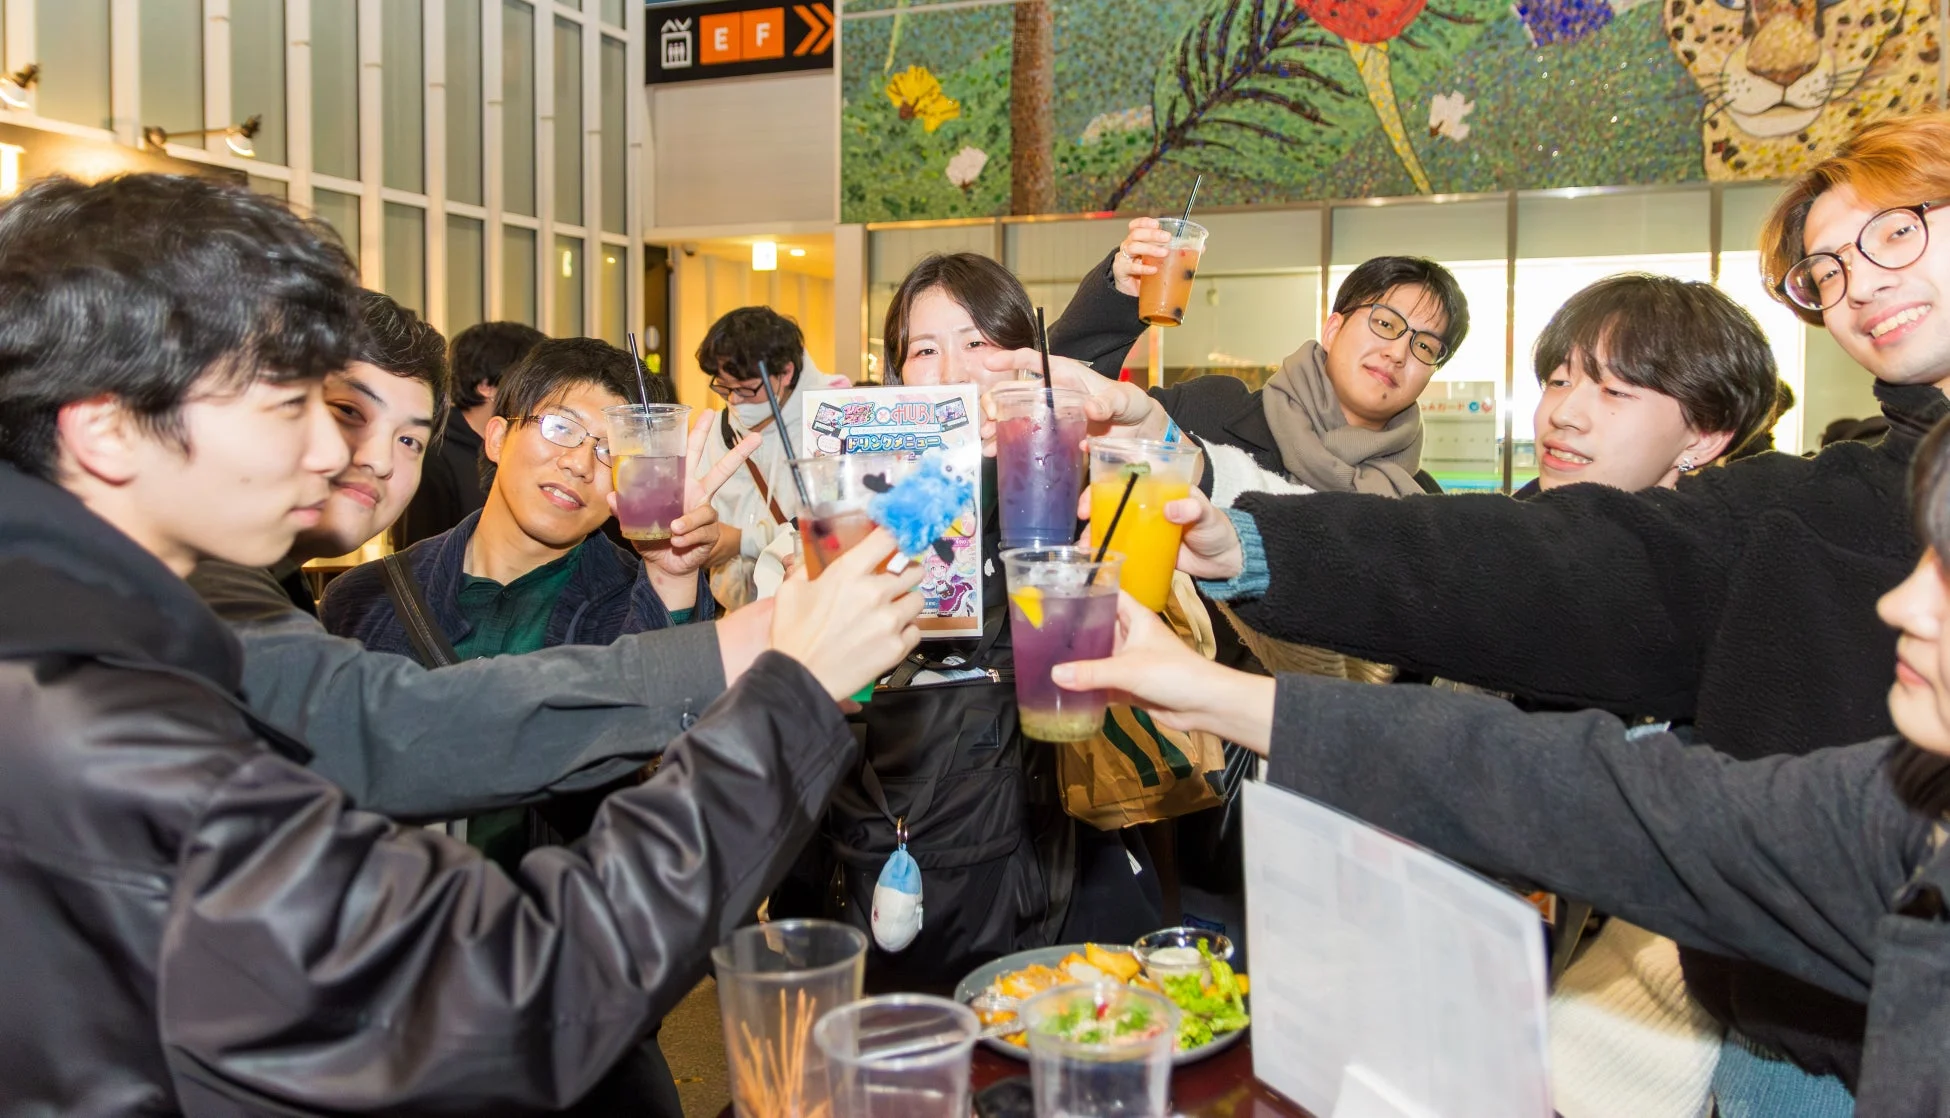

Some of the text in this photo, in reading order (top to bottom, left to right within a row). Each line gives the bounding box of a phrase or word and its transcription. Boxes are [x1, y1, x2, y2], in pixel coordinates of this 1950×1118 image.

[714, 22, 771, 51] E F
[848, 436, 940, 451] ドリンクメニュー
